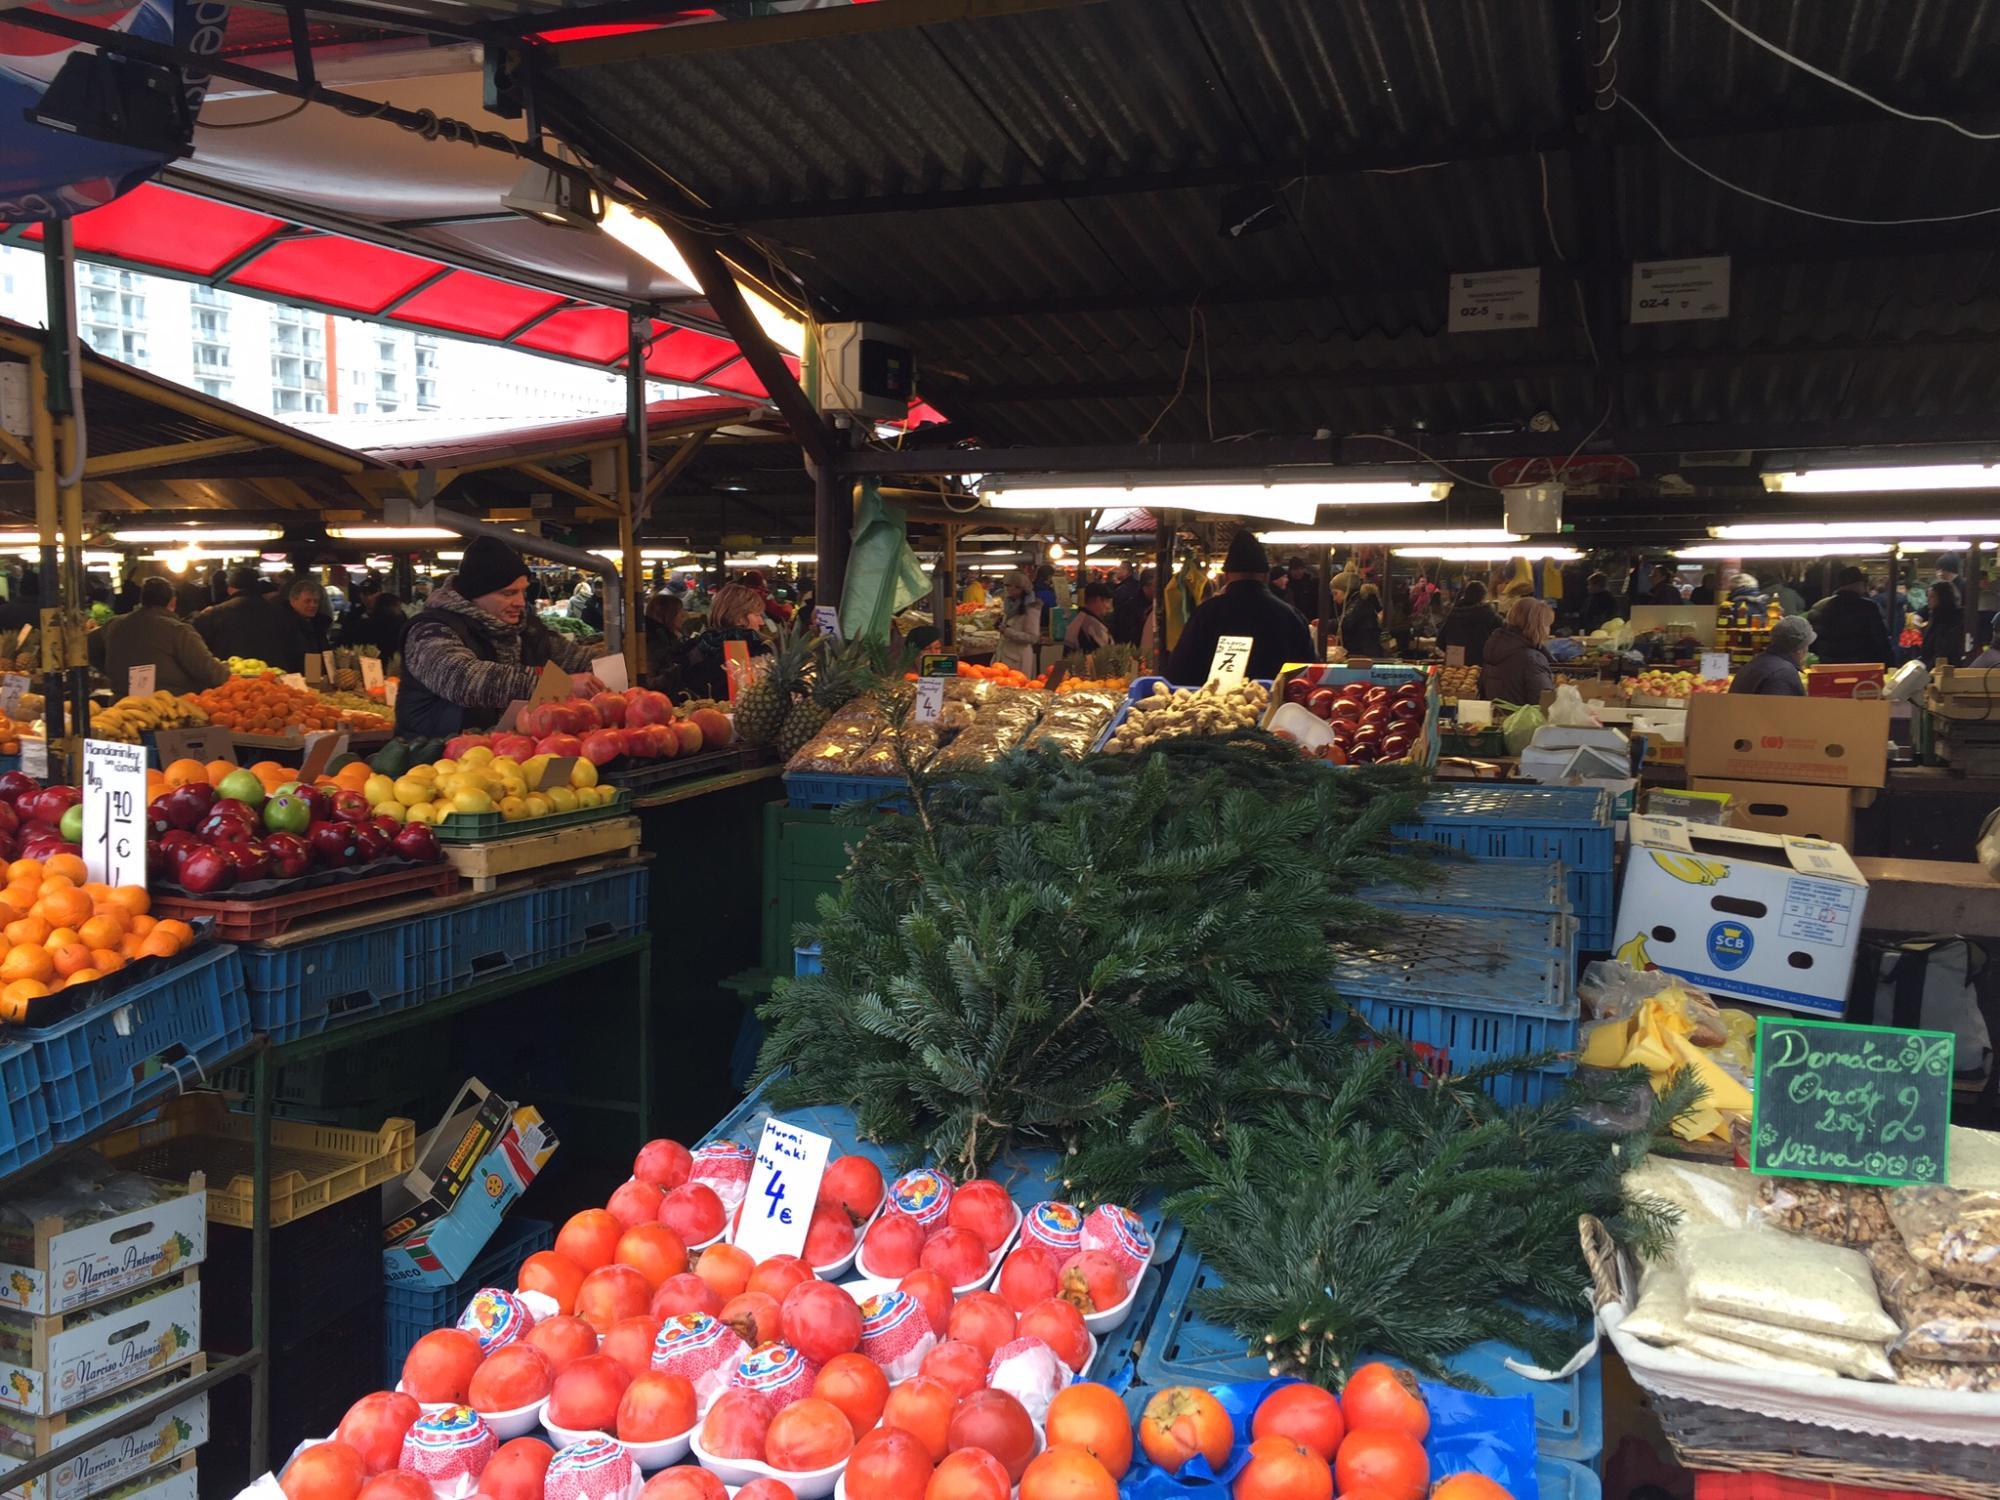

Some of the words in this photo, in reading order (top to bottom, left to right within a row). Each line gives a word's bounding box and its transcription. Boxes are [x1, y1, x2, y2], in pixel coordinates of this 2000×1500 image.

[1461, 306, 1489, 317] OZ-5
[1640, 298, 1670, 309] OZ-4
[1715, 935, 1745, 949] SCB
[775, 1141, 806, 1161] Kaki
[79, 1262, 119, 1285] Narciso
[121, 1245, 164, 1272] Antonio
[384, 1268, 422, 1281] nasco
[77, 1359, 117, 1384] Narciso
[119, 1341, 161, 1367] Antonio
[74, 1454, 116, 1480] Narciso
[118, 1435, 162, 1461] Antonio
